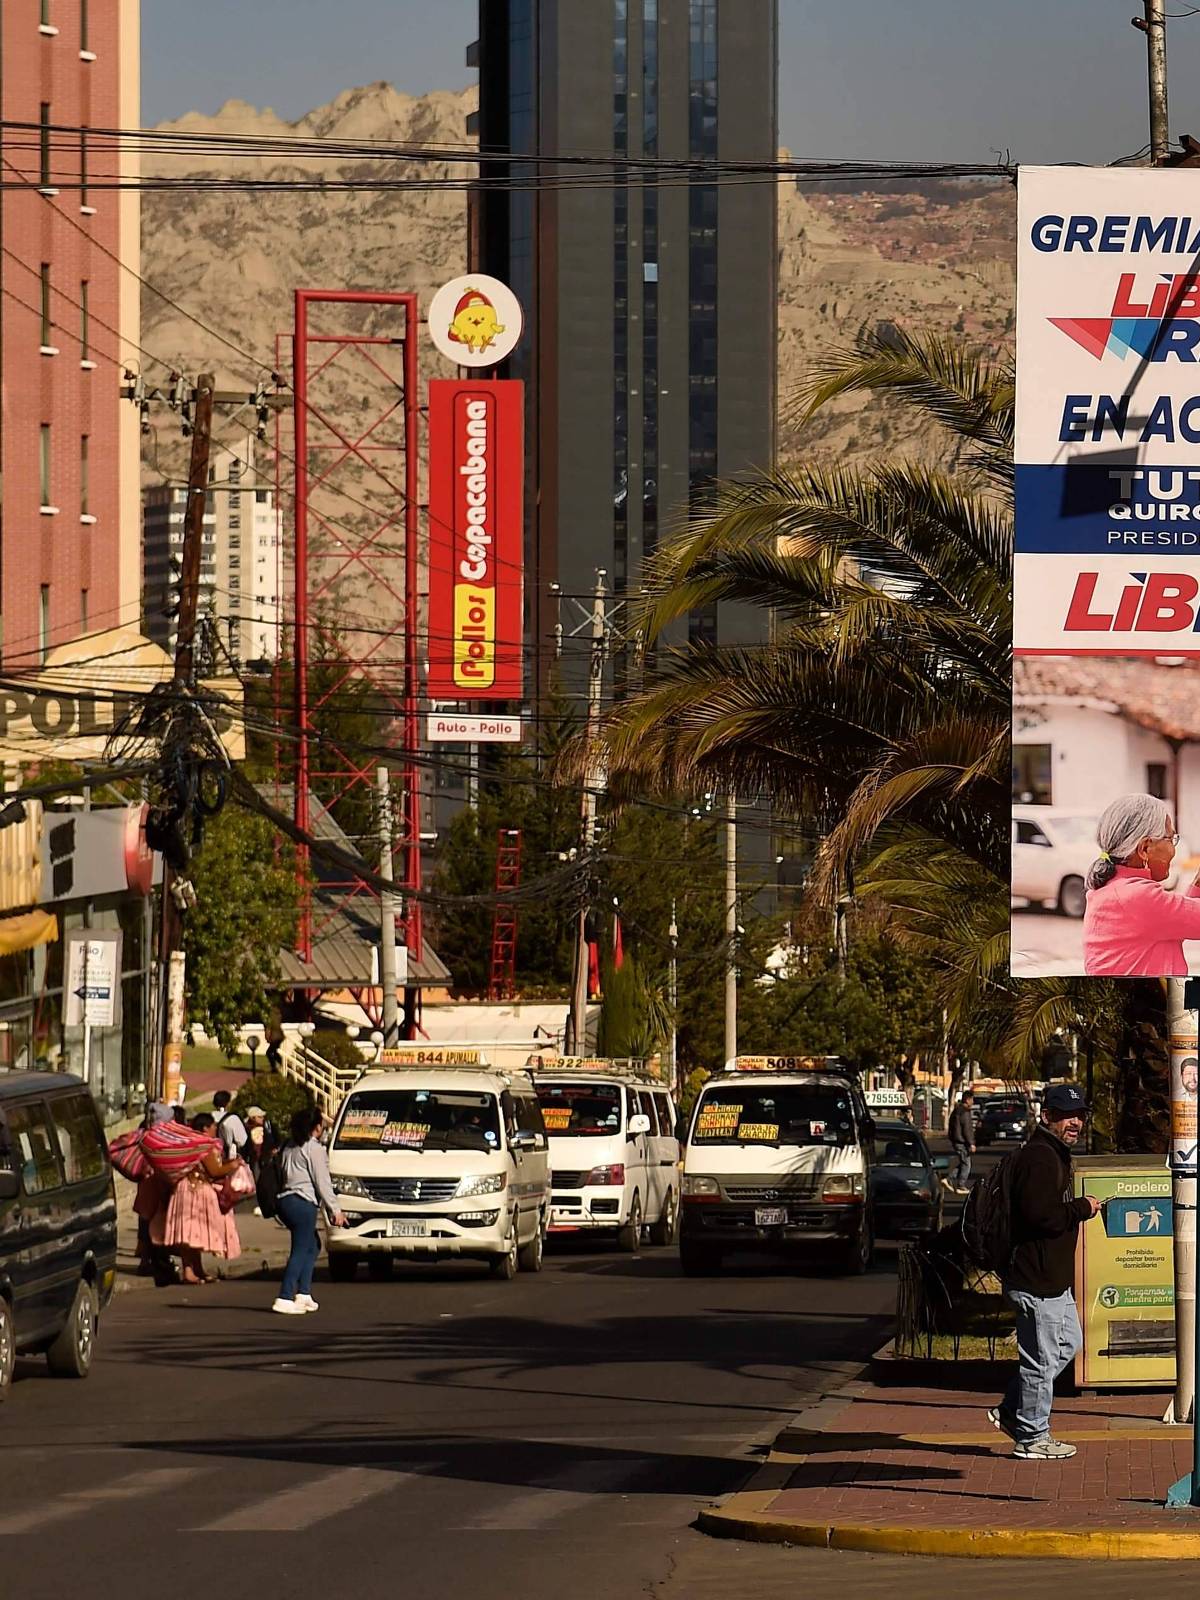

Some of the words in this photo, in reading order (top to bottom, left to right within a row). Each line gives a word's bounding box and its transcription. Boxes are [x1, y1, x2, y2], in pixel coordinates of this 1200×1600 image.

[1058, 395, 1131, 442] EN
[459, 400, 492, 581] Copacabana
[460, 594, 486, 678] Pollos
[437, 722, 466, 734] Auto
[480, 722, 512, 734] Pollo
[417, 1051, 443, 1063] 844
[557, 1058, 582, 1068] 922
[766, 1057, 796, 1069] 808
[1117, 1182, 1170, 1193] Papelero
